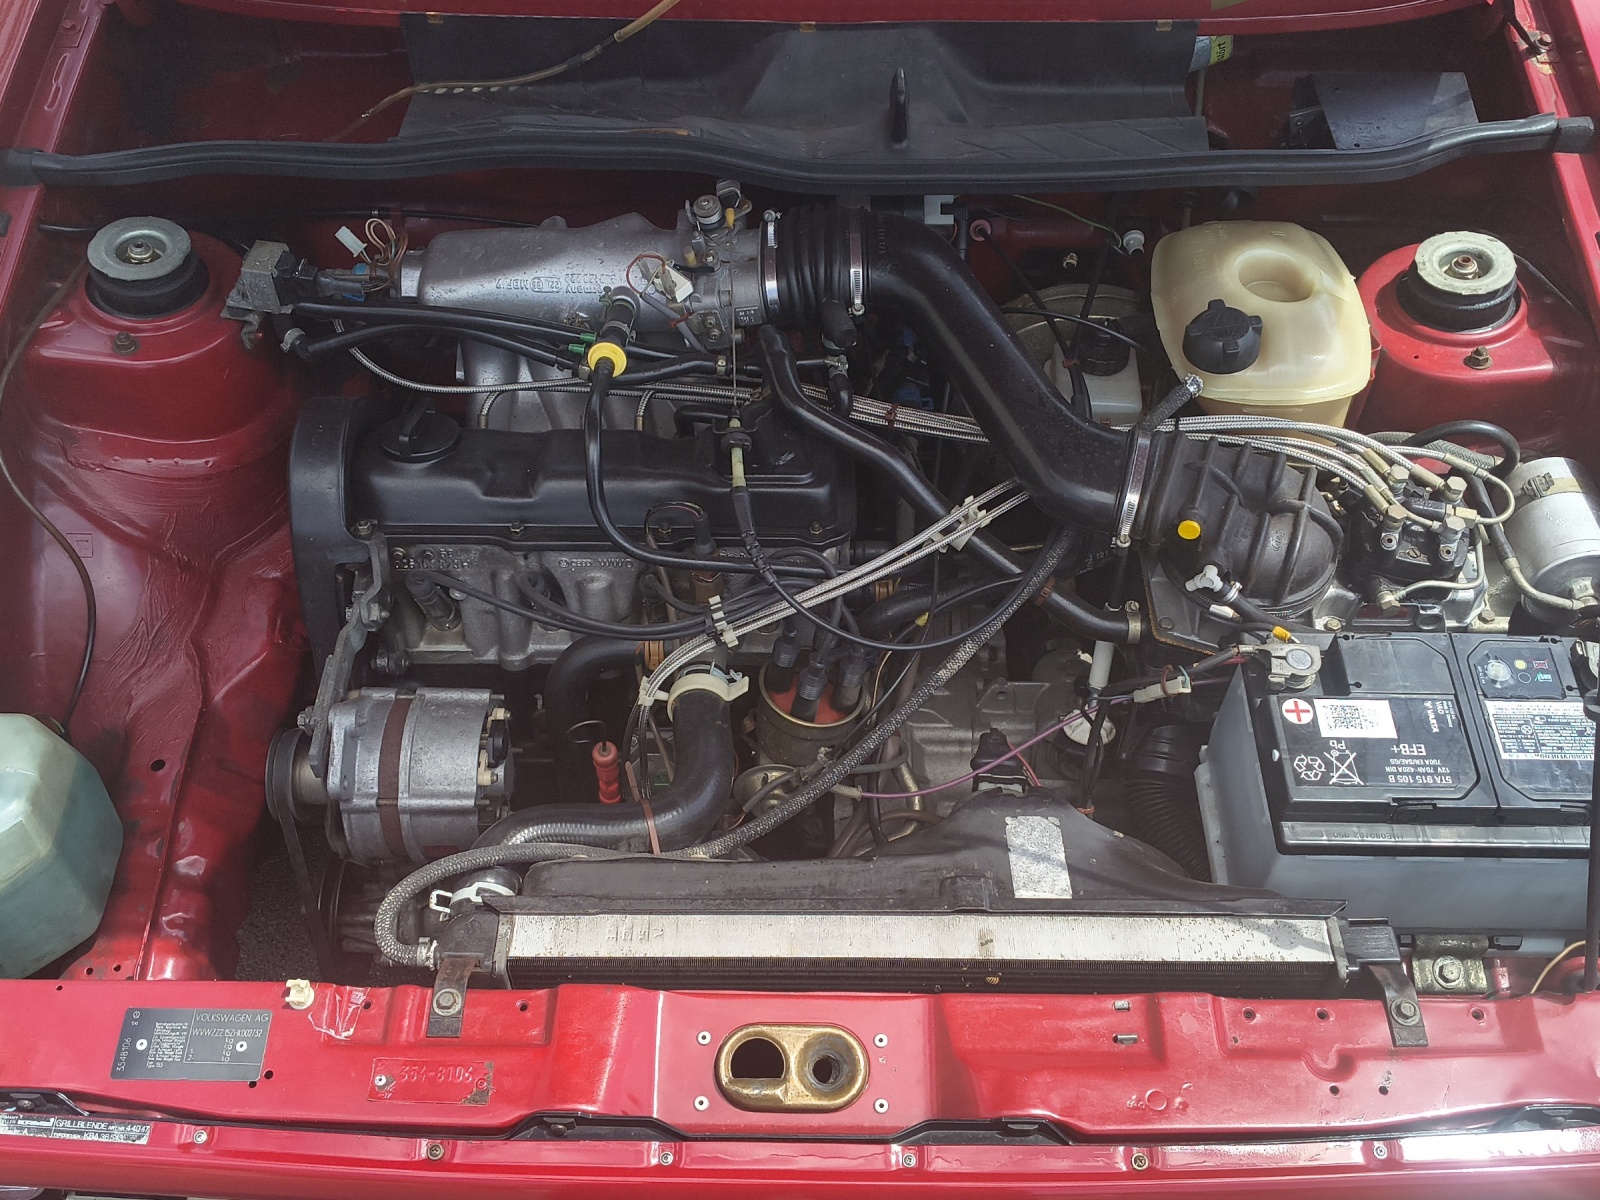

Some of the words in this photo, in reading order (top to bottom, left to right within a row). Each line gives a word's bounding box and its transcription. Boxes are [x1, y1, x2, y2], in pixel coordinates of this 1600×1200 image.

[1329, 739, 1346, 749] Pb
[1390, 743, 1426, 755] EFB+
[1388, 774, 1395, 782] B
[1397, 774, 1414, 783] 105
[1415, 775, 1433, 783] 915
[1434, 775, 1452, 784] 5TA
[195, 1013, 251, 1023] VOLKSWAGEN
[254, 1013, 269, 1023] AG
[115, 1037, 132, 1072] 3548106
[56, 1119, 108, 1130] GRILLBLENDE
[82, 1131, 99, 1140] KBA
